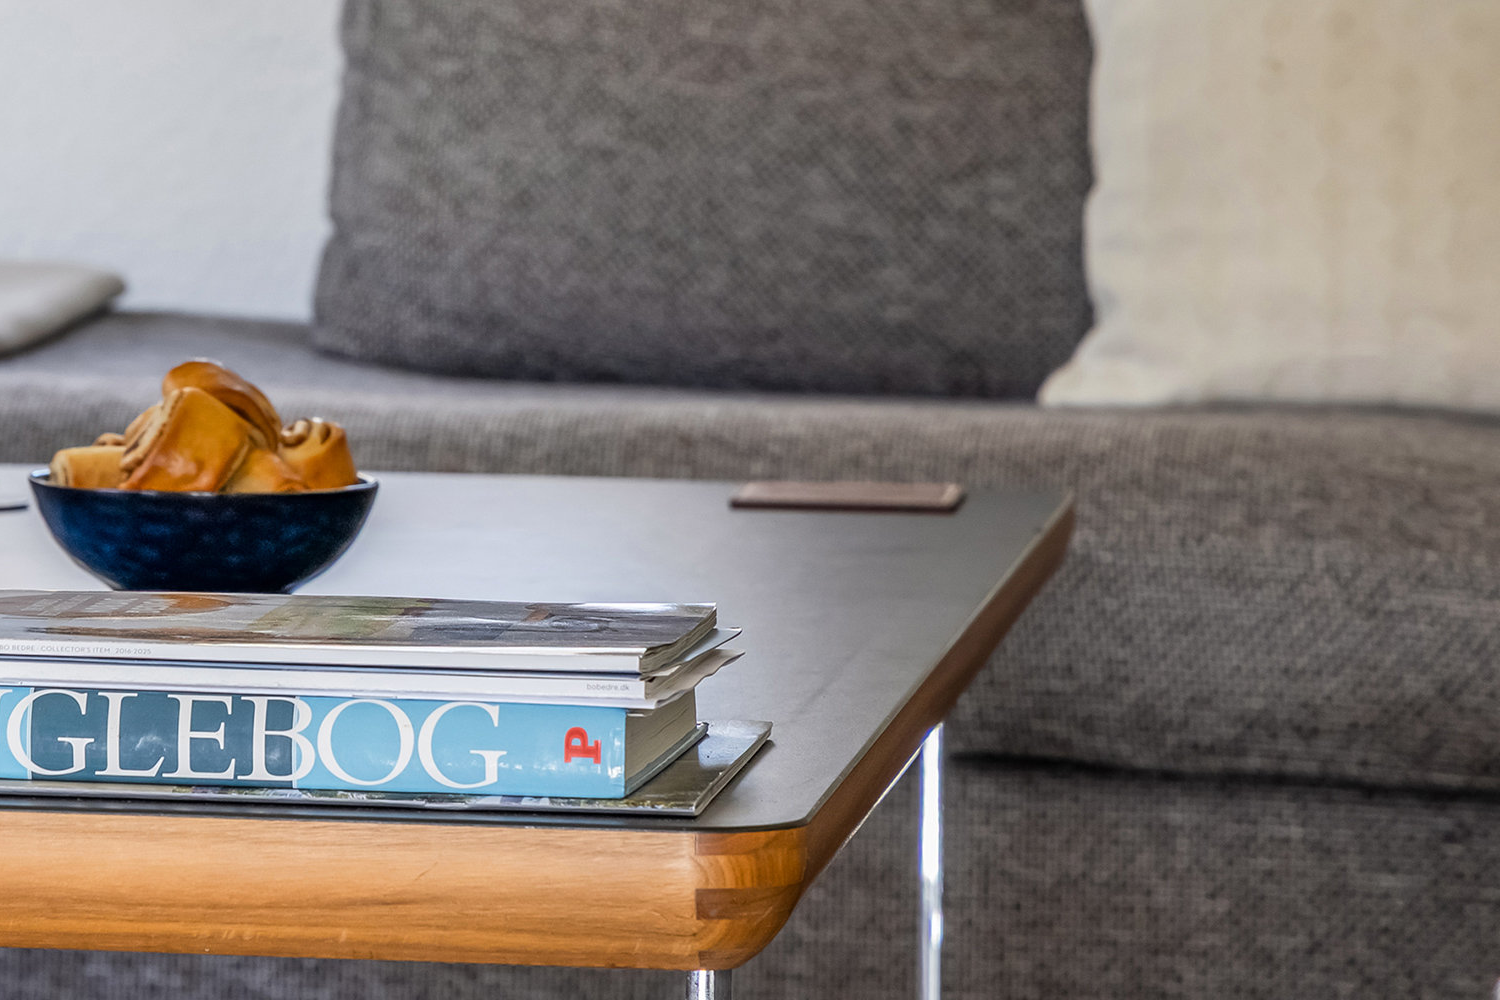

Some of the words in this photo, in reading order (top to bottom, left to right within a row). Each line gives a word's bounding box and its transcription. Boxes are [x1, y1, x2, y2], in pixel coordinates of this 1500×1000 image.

[40, 645, 91, 653] COLLECTOR'S
[586, 683, 630, 691] bobedre.dk
[564, 726, 602, 764] P
